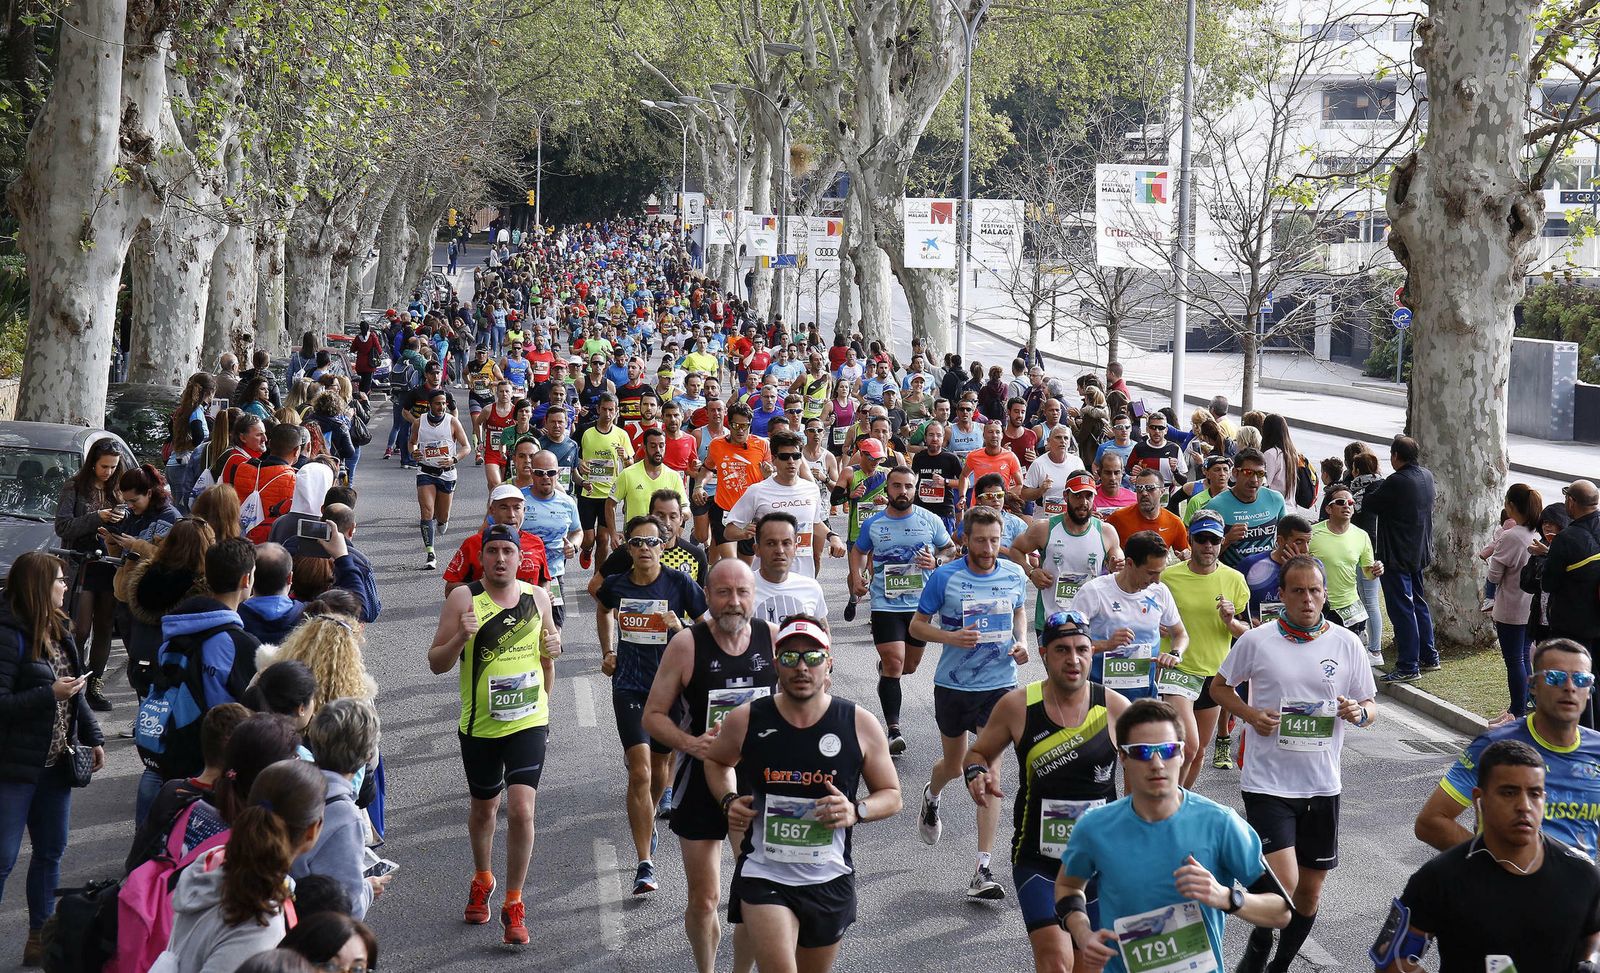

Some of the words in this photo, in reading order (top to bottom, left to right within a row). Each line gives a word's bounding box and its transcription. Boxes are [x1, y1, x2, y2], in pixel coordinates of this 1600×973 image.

[771, 498, 812, 509] ORACLE
[888, 577, 910, 586] 1044
[622, 616, 650, 627] 3907
[1108, 661, 1136, 672] 1096
[1164, 671, 1189, 684] 1873
[495, 691, 525, 705] 2071
[1285, 718, 1317, 732] 1411
[1031, 733, 1084, 769] BUITRERAS
[1035, 750, 1079, 778] RUNNING
[771, 821, 811, 839] 1567
[1131, 936, 1178, 963] 1791
